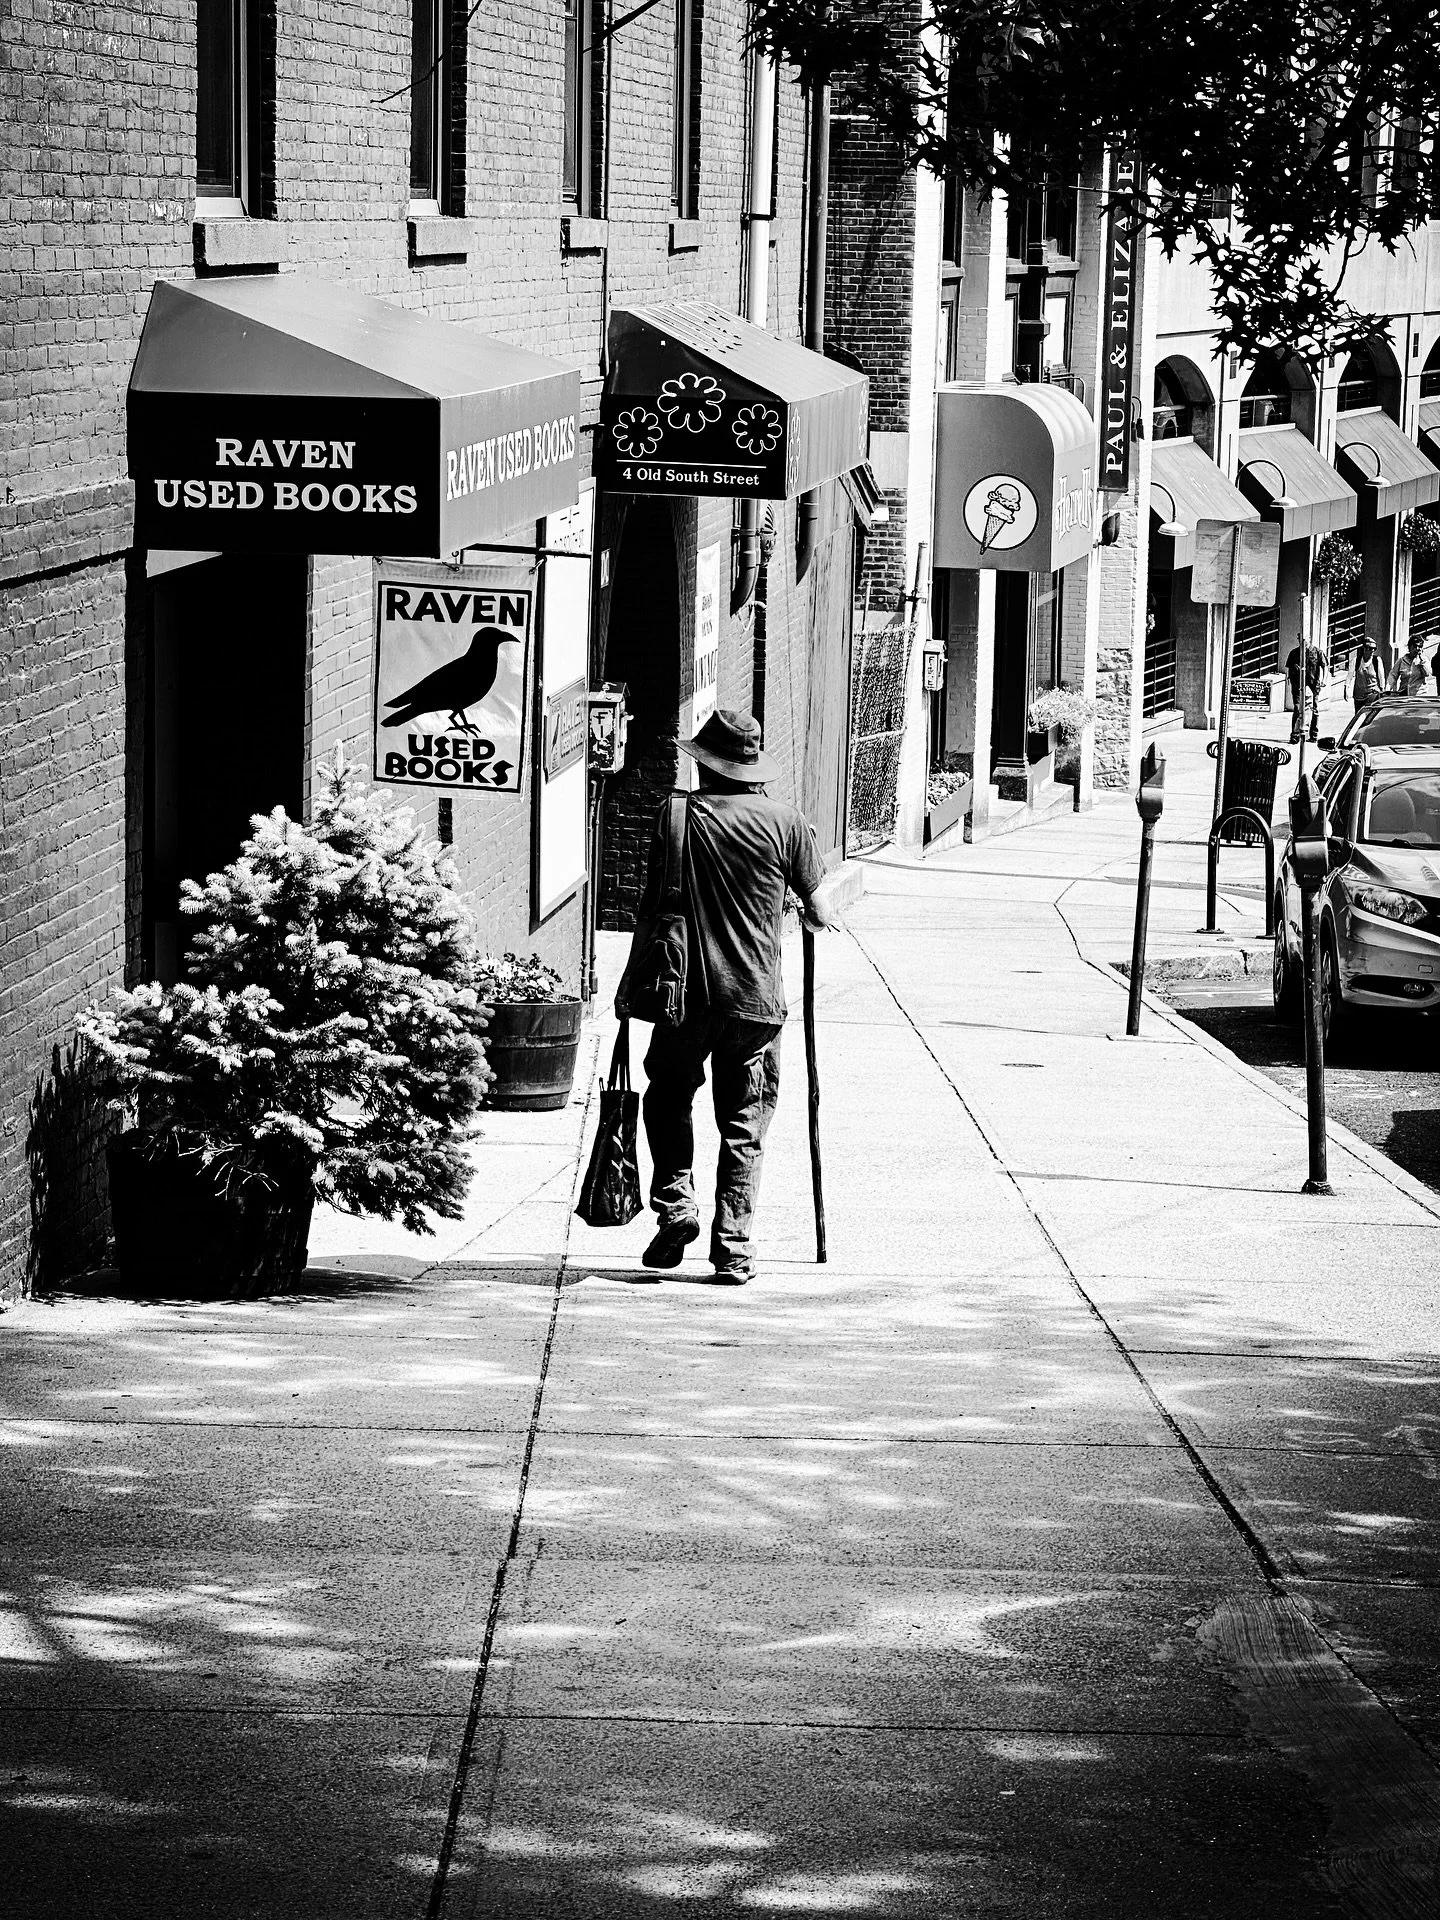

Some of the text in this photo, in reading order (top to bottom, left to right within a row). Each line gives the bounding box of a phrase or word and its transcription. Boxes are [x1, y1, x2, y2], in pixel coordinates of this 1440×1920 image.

[1109, 343, 1128, 369] &
[1105, 379, 1126, 474] PAUL
[215, 438, 356, 469] RAVEN
[446, 415, 575, 501] RAVEN USED BOOKS
[622, 467, 760, 486] 4 Old South Street
[154, 478, 418, 514] USED BOOKS
[386, 587, 525, 627] RAVEN
[407, 733, 496, 761] USED
[384, 752, 515, 787] BOOKS
